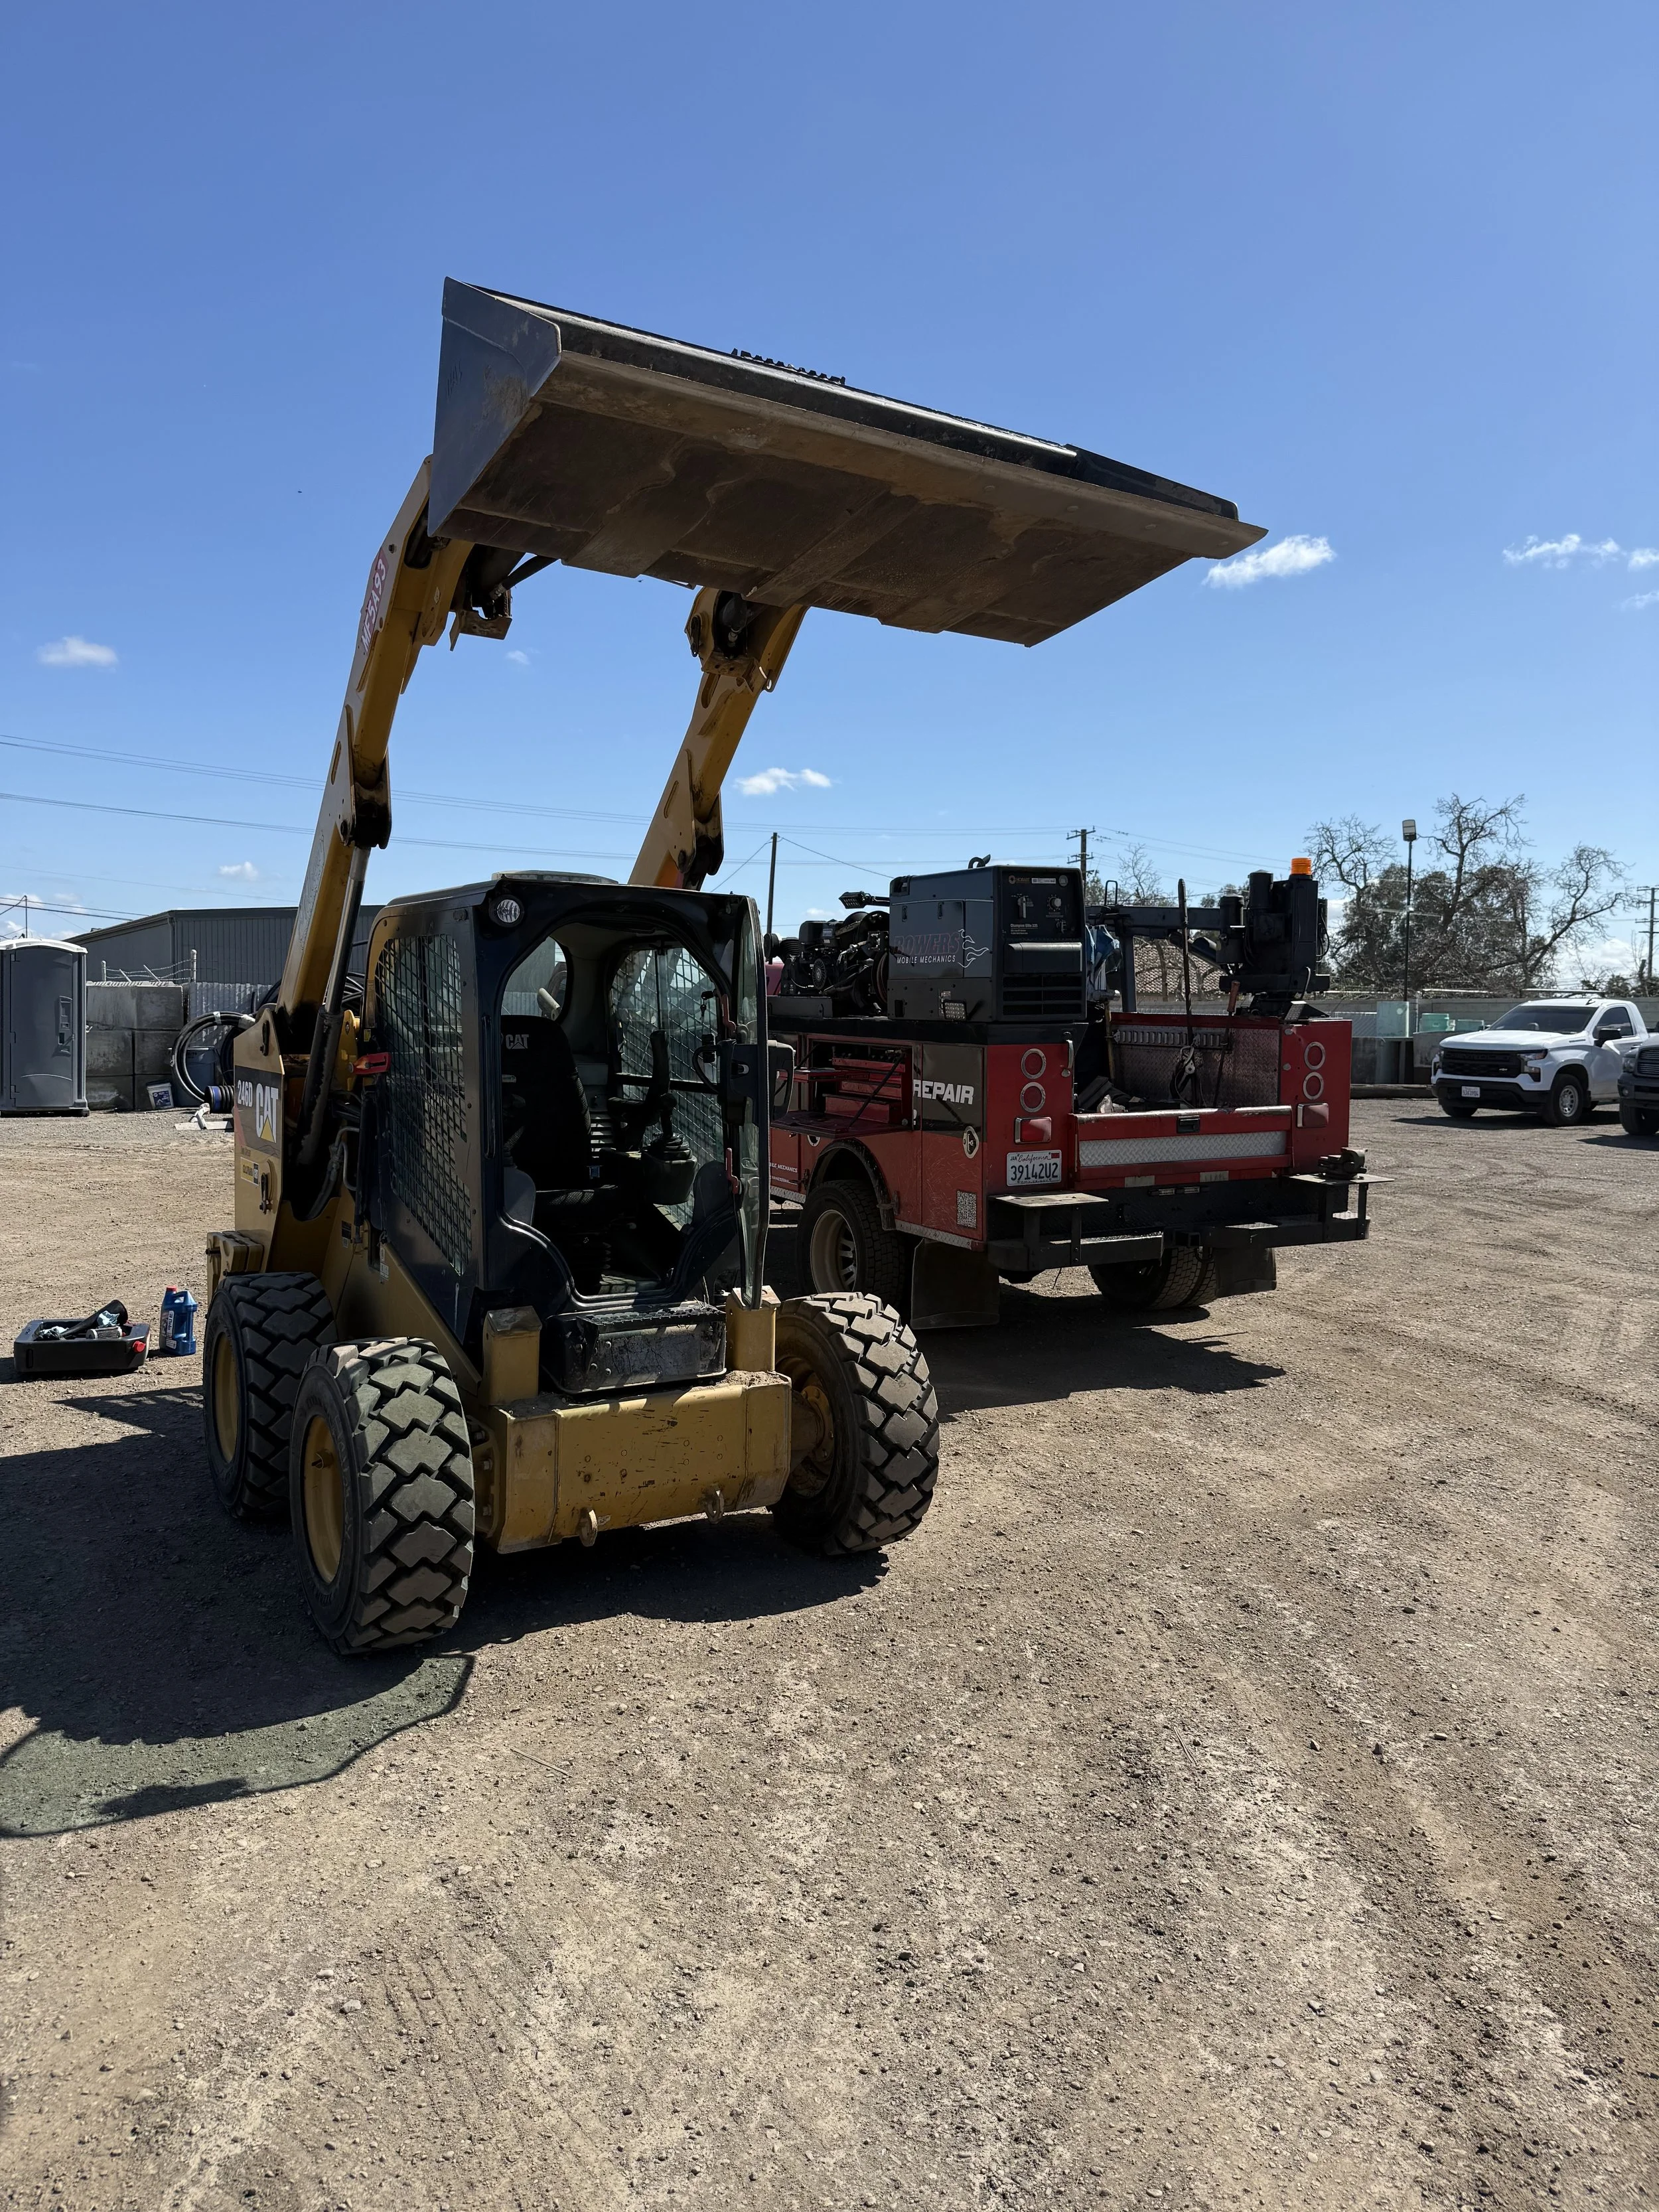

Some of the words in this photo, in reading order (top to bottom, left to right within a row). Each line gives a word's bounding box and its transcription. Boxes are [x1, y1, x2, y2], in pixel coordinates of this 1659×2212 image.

[506, 1034, 529, 1049] CAT
[238, 1080, 253, 1107] 246D
[256, 1083, 279, 1143] CAT
[1018, 1153, 1051, 1163] California
[1011, 1163, 1058, 1181] 39142U2
